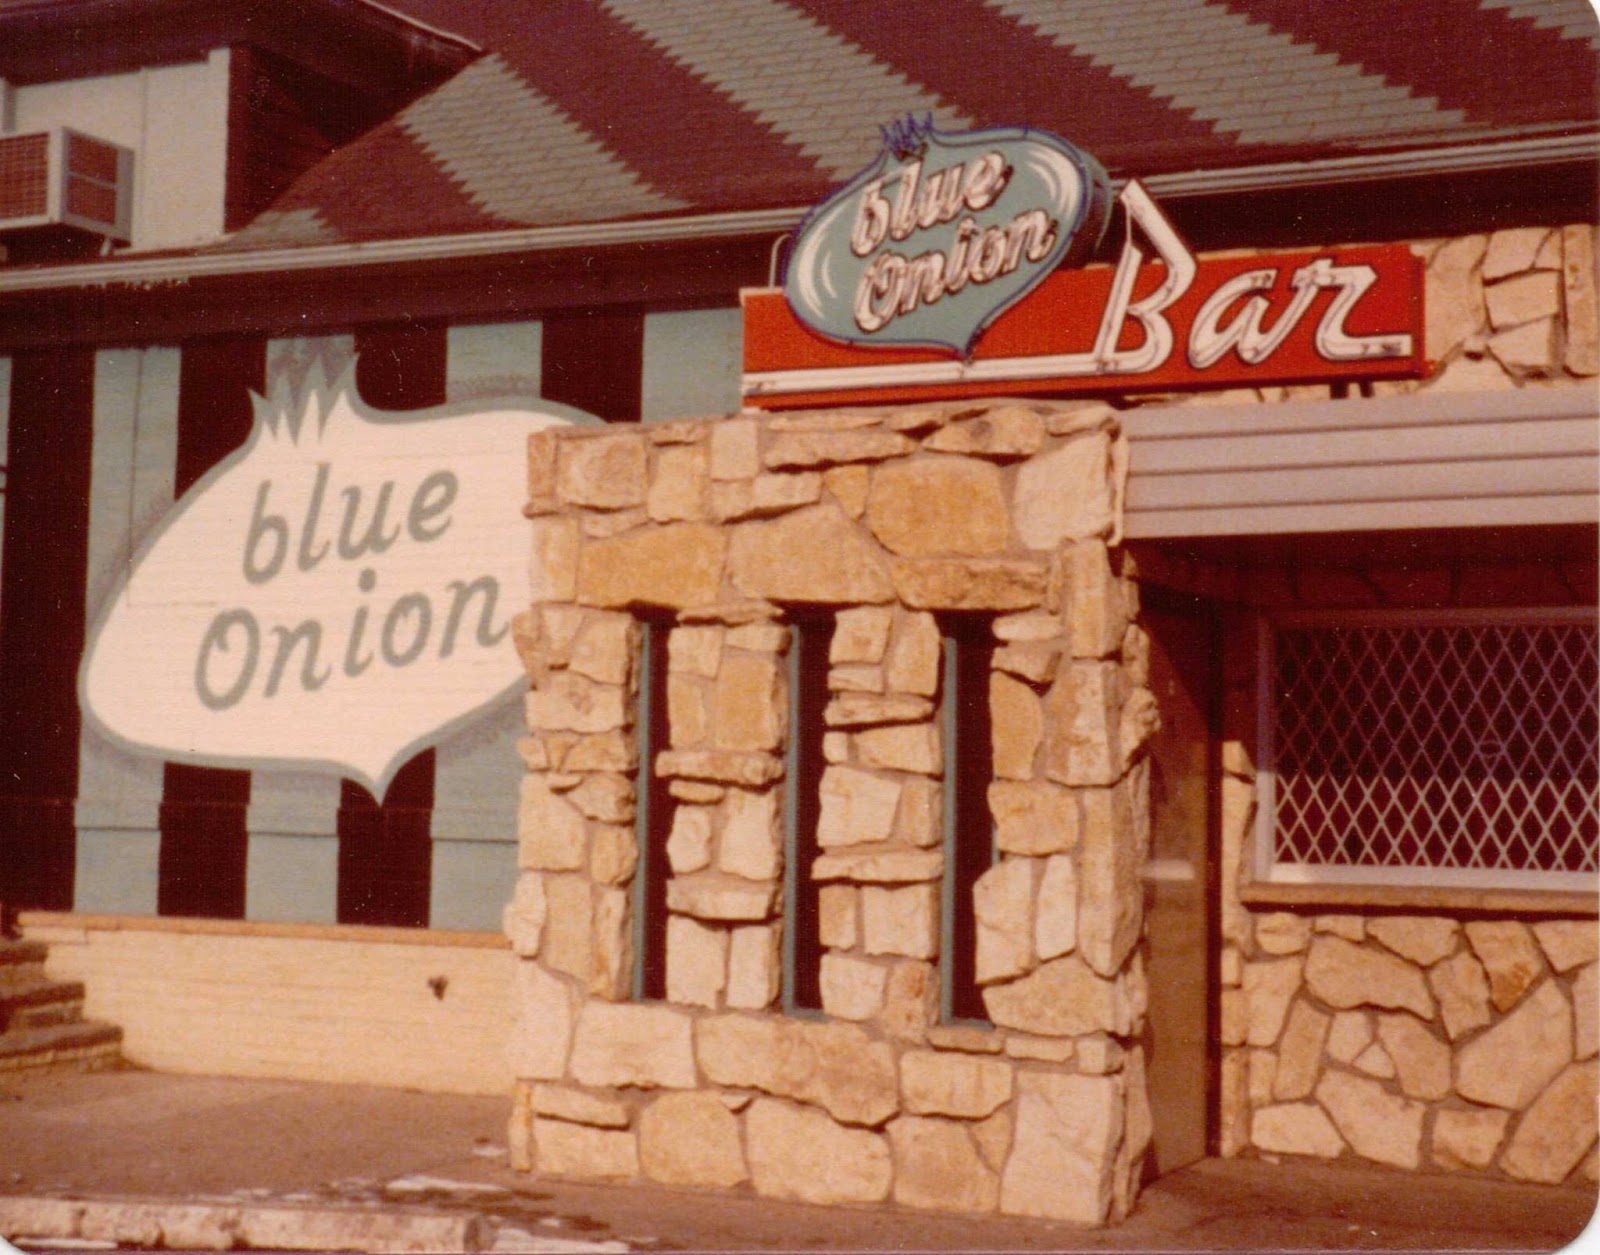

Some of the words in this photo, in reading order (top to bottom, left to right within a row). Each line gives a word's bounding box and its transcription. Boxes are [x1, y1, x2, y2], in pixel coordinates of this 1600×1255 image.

[849, 151, 1012, 256] blue
[852, 209, 1058, 332] Onion
[1094, 178, 1412, 374] Bar
[242, 460, 459, 585] blue
[195, 569, 508, 711] Onion
